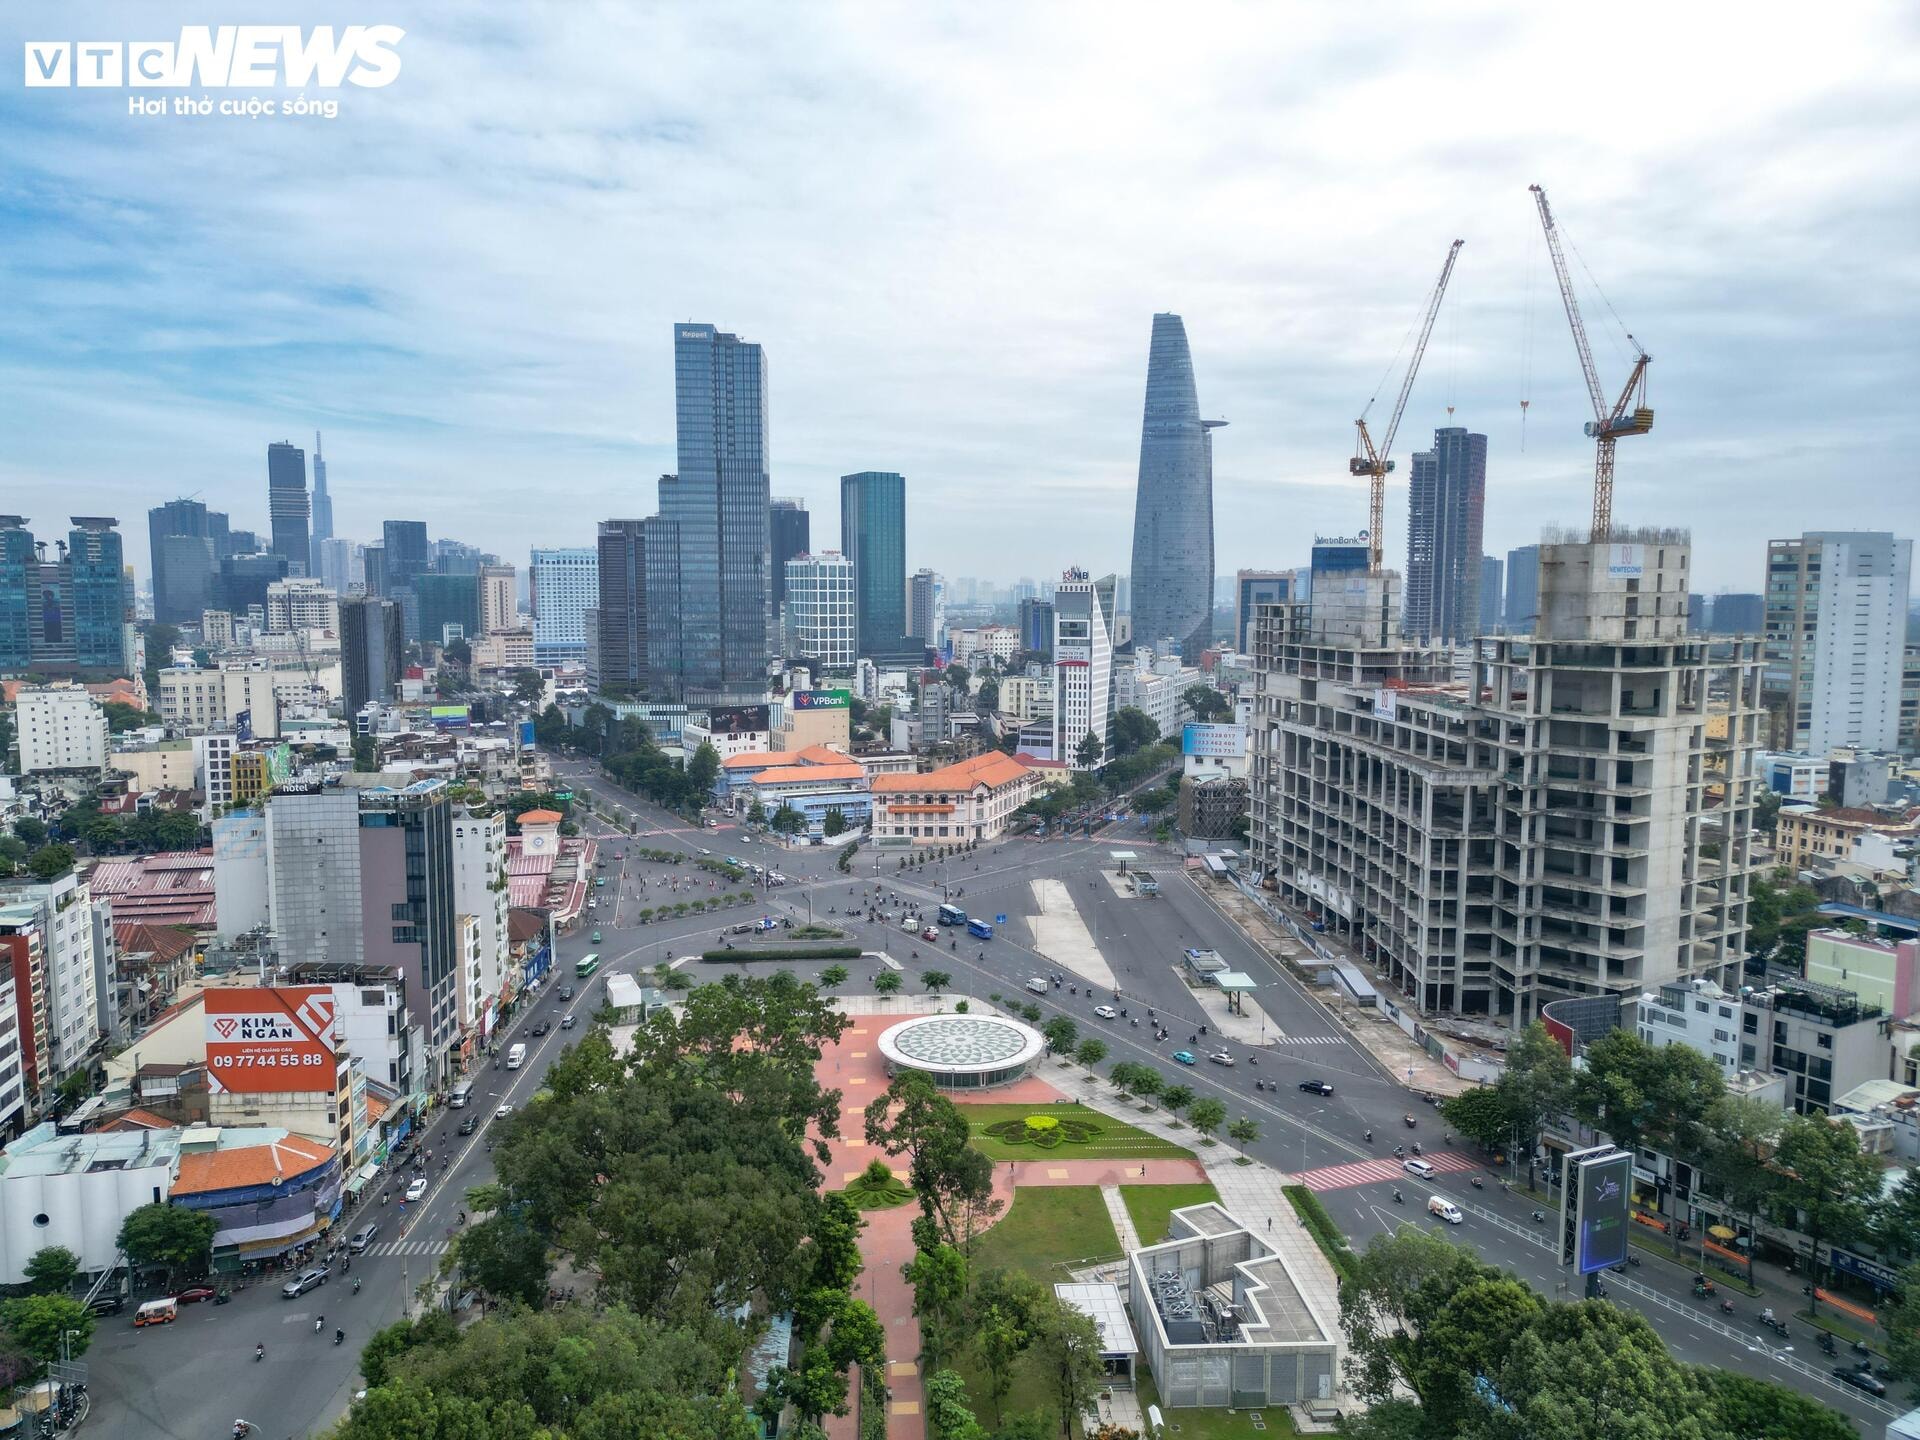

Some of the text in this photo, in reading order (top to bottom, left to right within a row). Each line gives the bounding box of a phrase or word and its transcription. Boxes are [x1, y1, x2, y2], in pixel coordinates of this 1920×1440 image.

[812, 696, 845, 705] VPBank
[282, 784, 308, 792] hotel
[241, 1017, 274, 1028] KIM
[242, 1028, 292, 1038] NGAN
